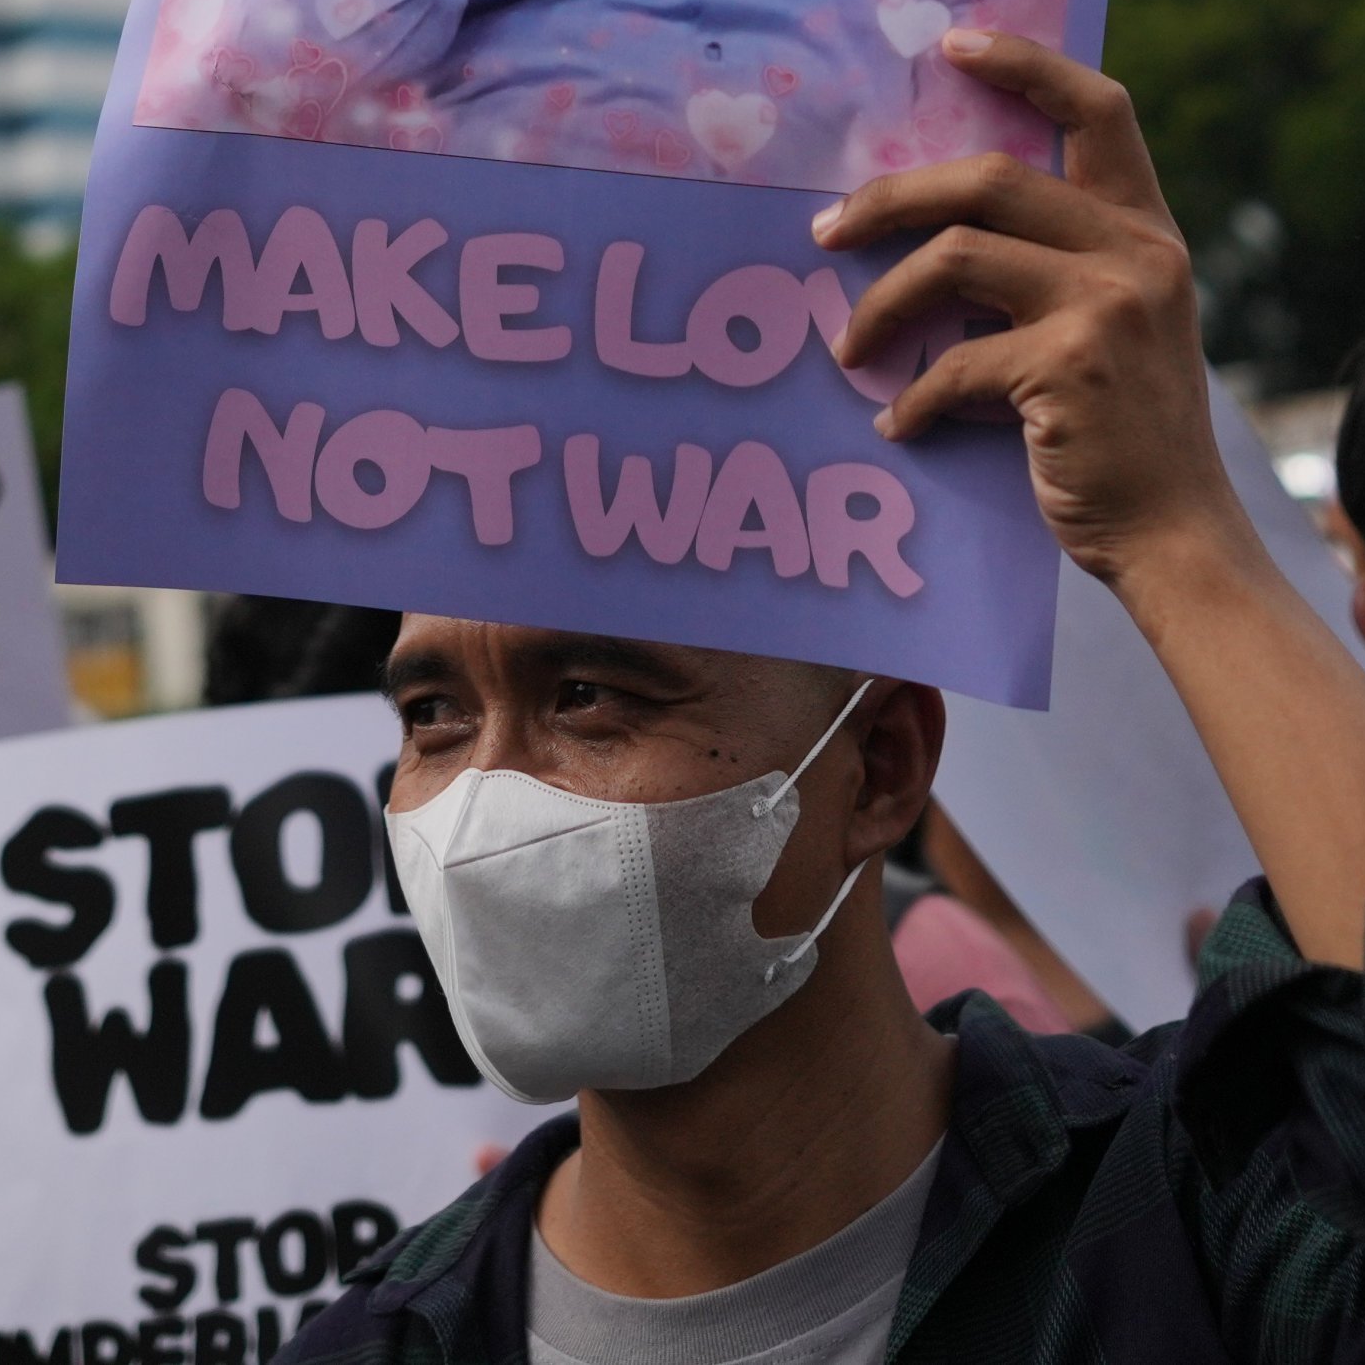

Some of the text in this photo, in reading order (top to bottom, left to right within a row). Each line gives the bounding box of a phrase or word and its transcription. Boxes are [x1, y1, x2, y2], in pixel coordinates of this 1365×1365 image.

[110, 205, 572, 363] MAKE
[203, 388, 925, 598] NOT WAR
[44, 928, 485, 1135] WAR
[135, 1199, 398, 1312] STOP
